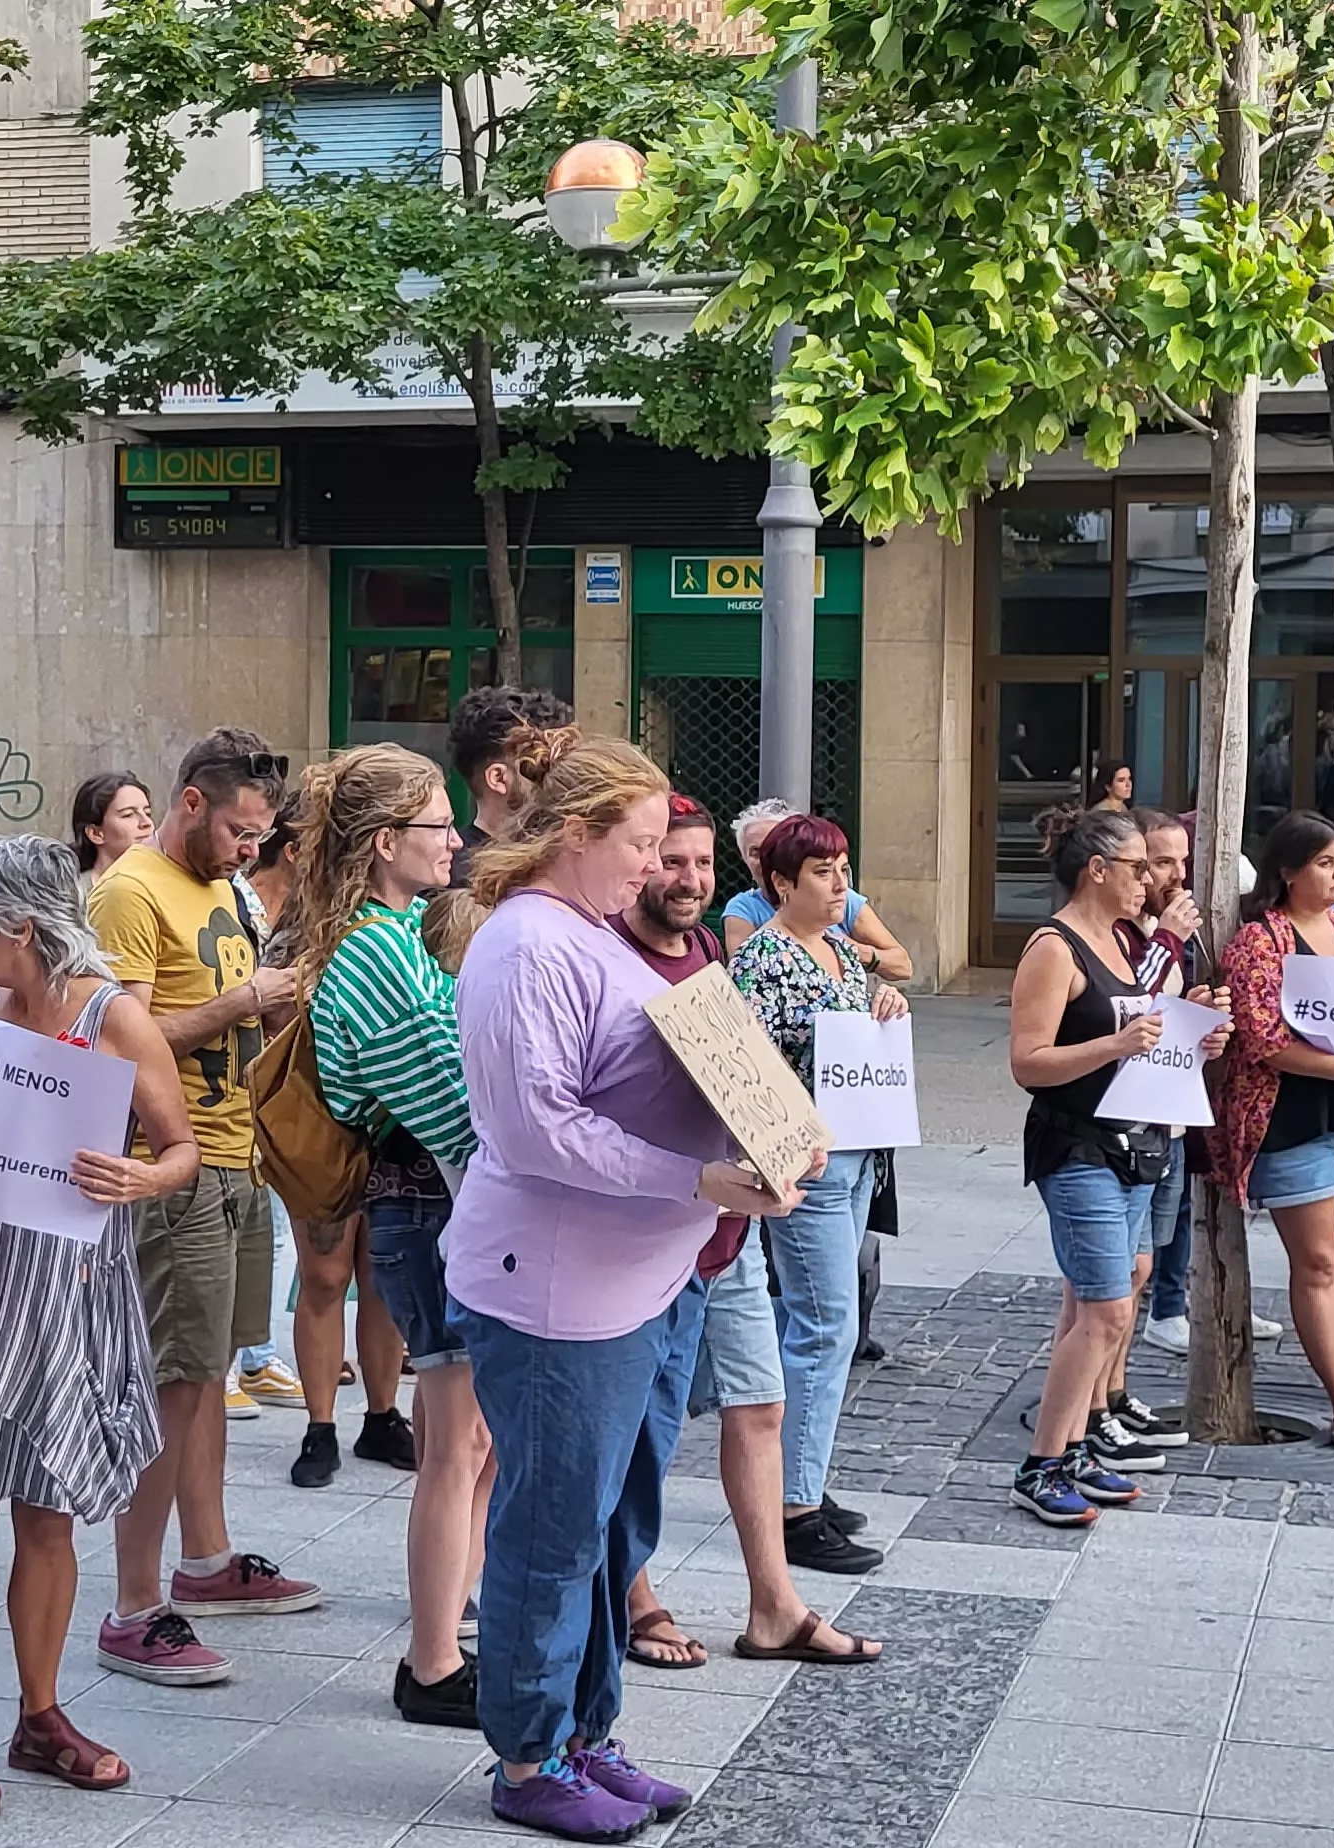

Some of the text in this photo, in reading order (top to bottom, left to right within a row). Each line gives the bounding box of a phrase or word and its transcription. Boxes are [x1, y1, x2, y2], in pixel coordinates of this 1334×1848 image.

[163, 452, 273, 480] ONCE
[134, 519, 227, 535] 15 54084
[717, 565, 763, 589] ON
[3, 1063, 71, 1098] MENOS
[821, 1062, 907, 1088] #SeAcabó
